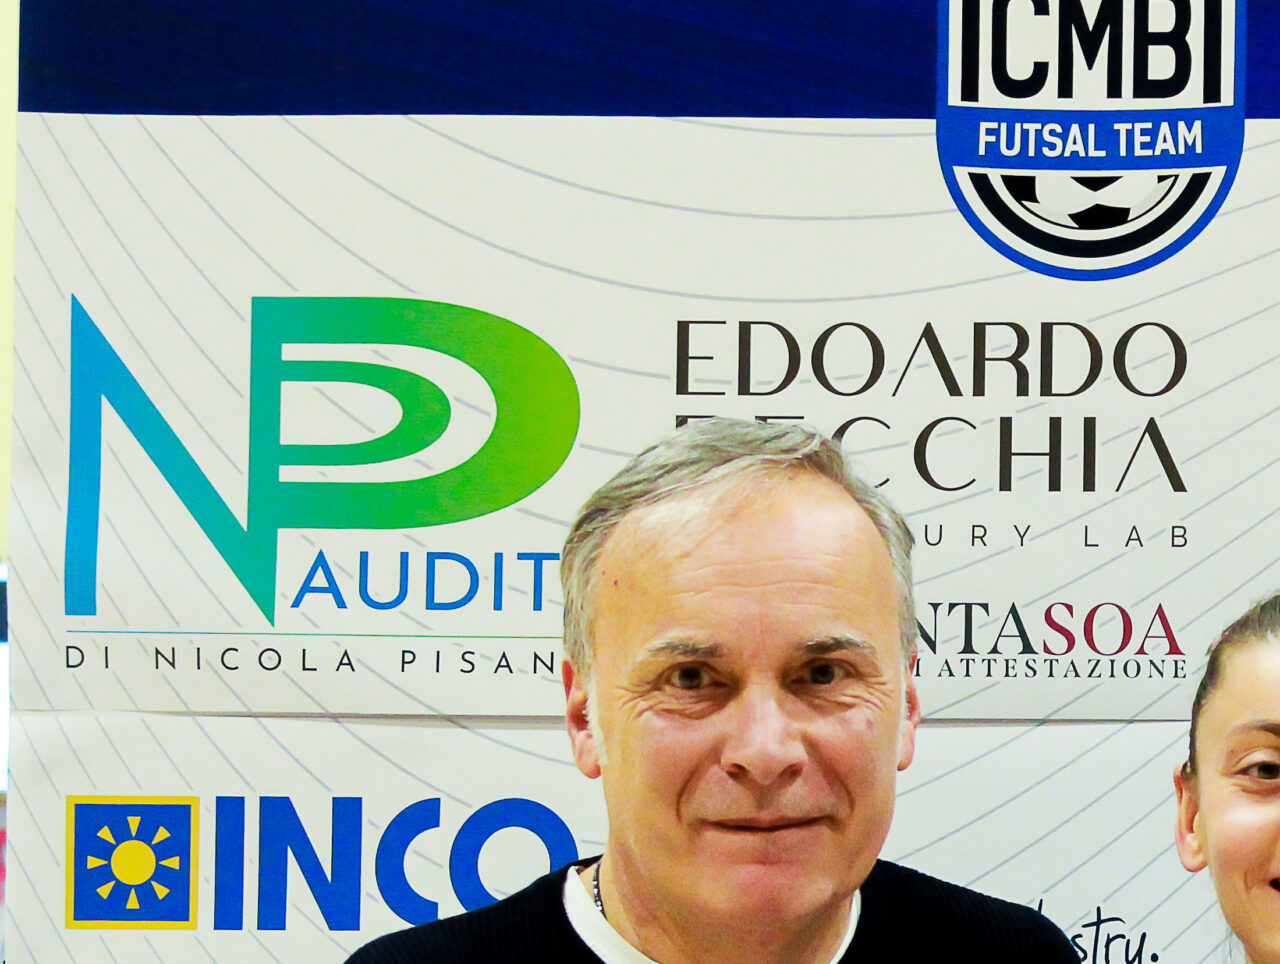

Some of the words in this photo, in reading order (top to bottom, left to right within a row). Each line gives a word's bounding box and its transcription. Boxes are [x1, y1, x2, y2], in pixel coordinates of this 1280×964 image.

[990, 0, 1192, 99] CMB
[977, 121, 1106, 158] FUTSAL
[1114, 120, 1203, 156] TEAM
[675, 320, 1188, 397] EDOARDO
[675, 415, 1188, 492] CCHIA
[1084, 524, 1188, 548] LAB
[290, 549, 561, 612] AUDIT
[65, 646, 109, 669] DI
[155, 647, 357, 672] NICOLA
[401, 650, 555, 675] PISAN
[937, 658, 1187, 679] ATTESTAZIONE
[213, 796, 580, 931] INCO
